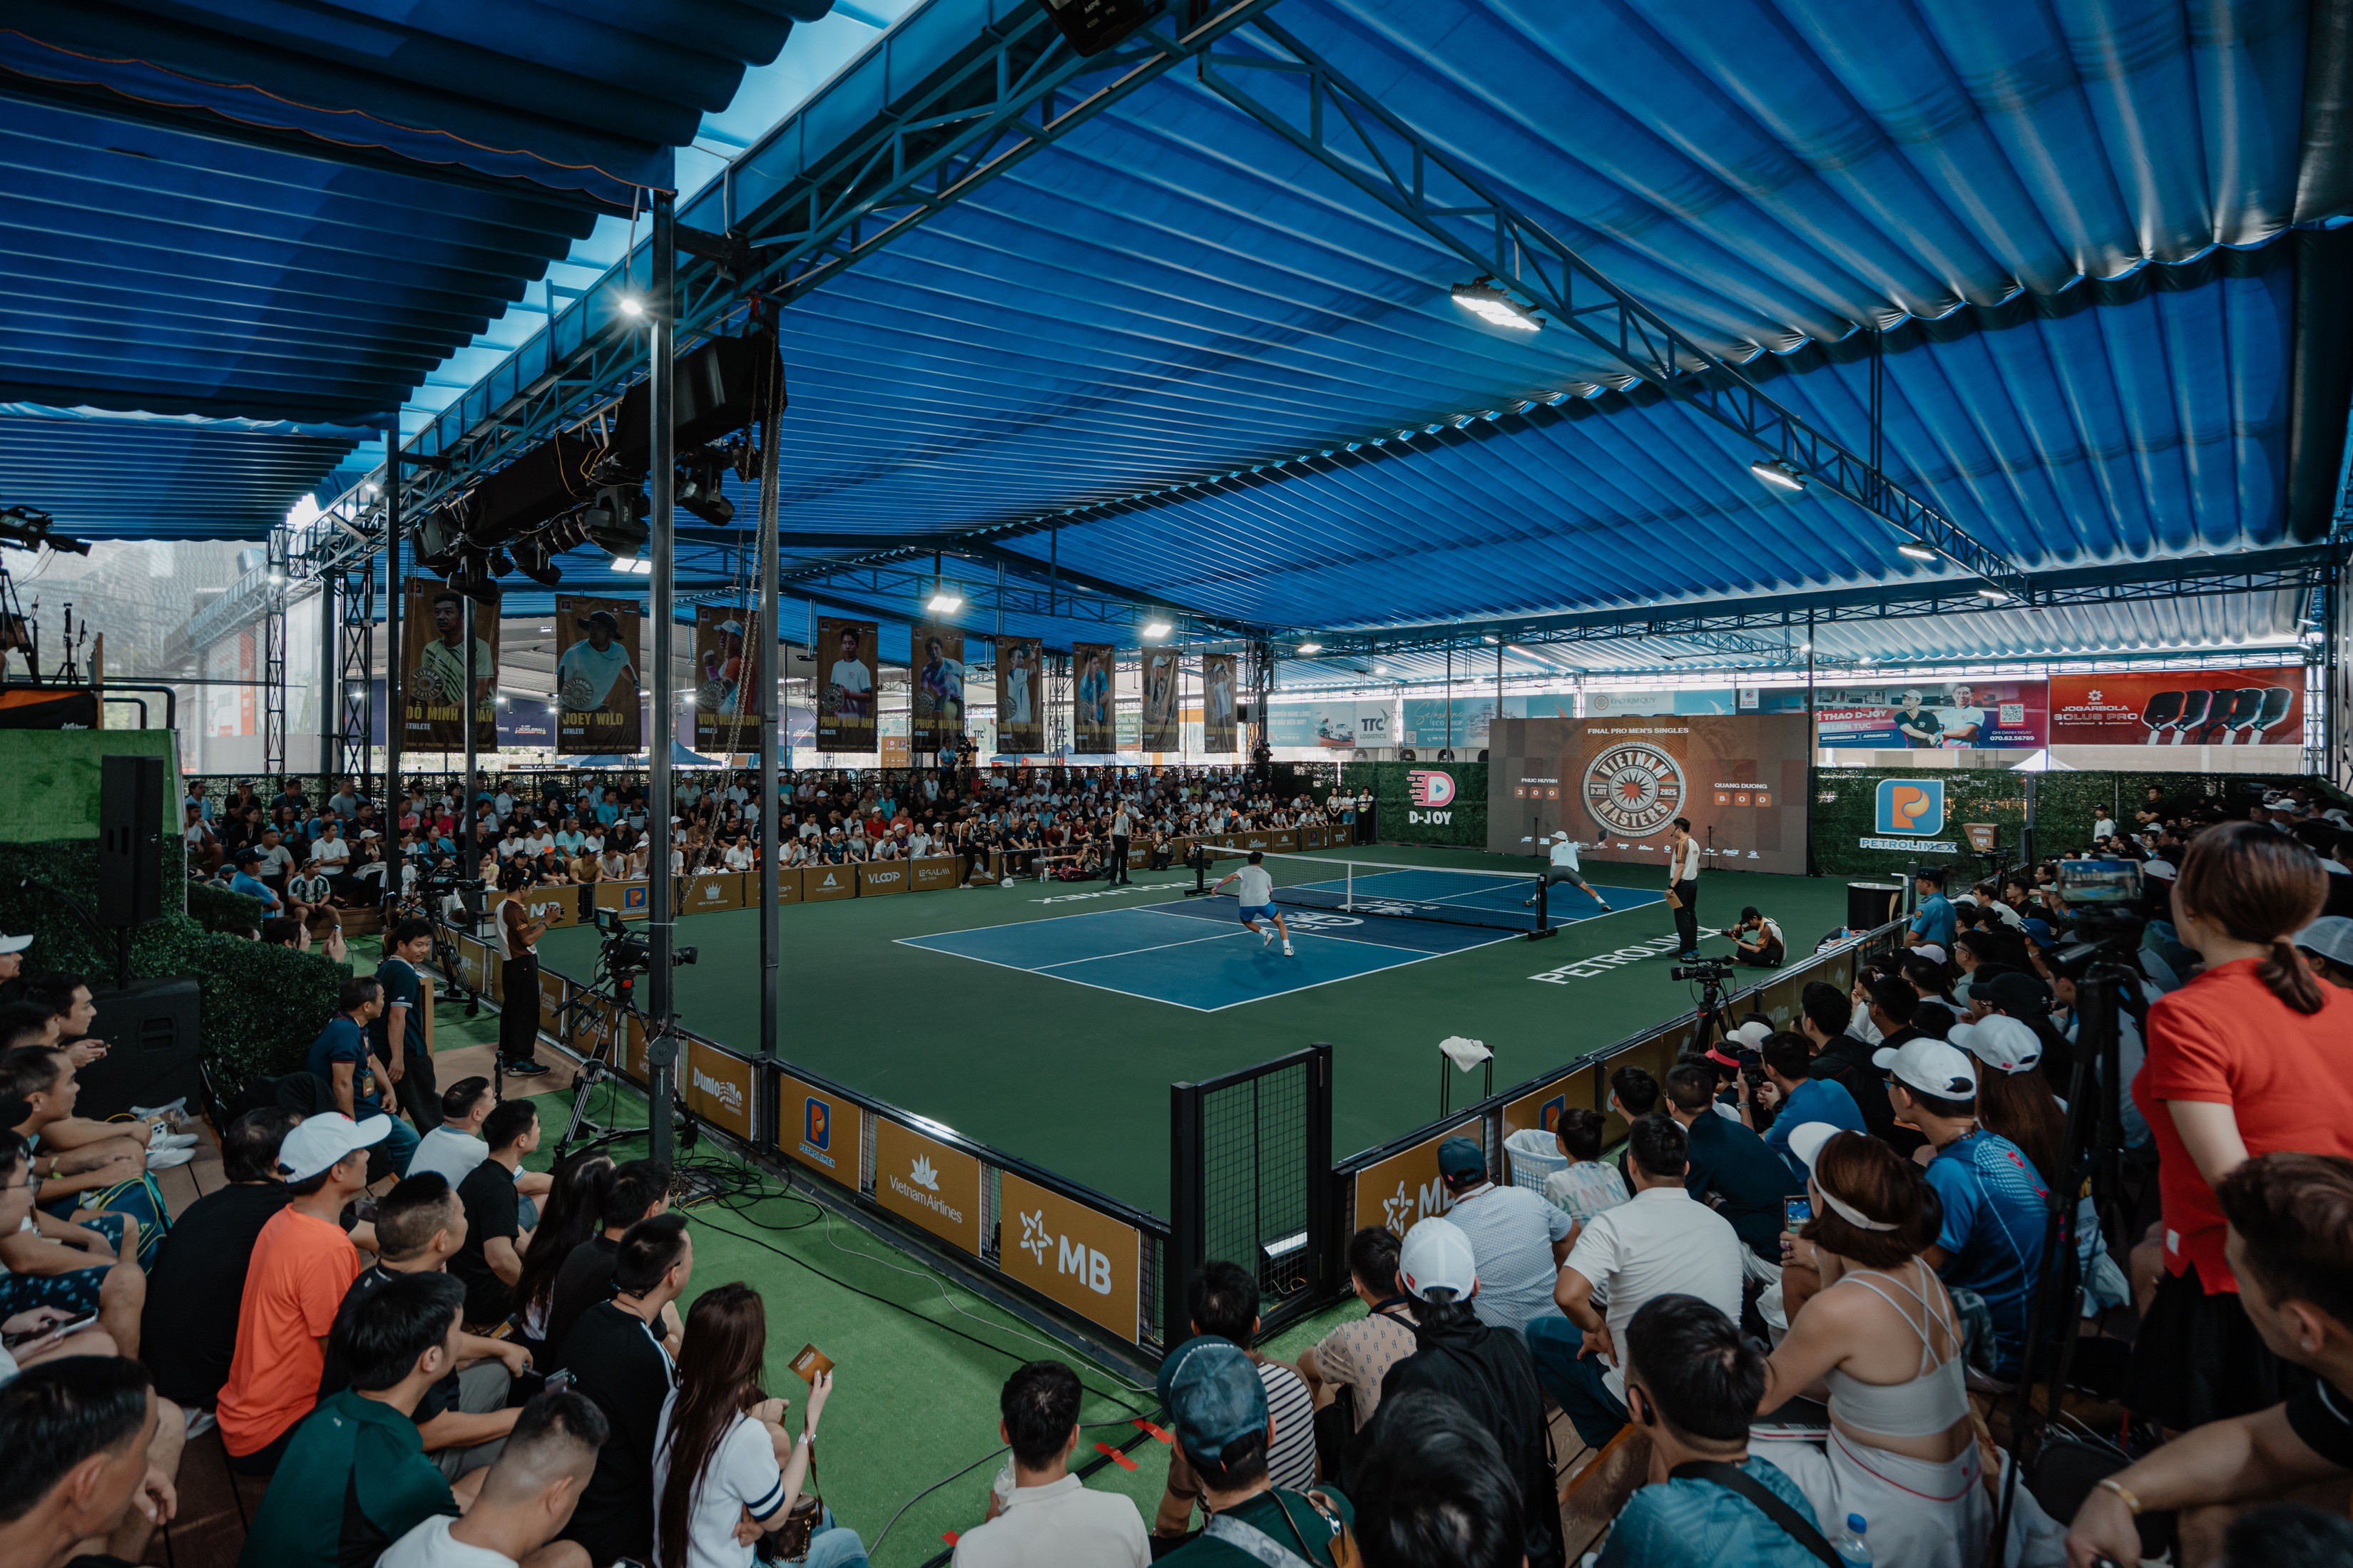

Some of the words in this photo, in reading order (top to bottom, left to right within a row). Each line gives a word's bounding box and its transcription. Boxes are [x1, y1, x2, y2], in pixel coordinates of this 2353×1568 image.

[428, 707, 459, 721] MINH
[563, 713, 592, 725] JOEY
[596, 713, 623, 725] WILD
[861, 717, 874, 728] ANH
[914, 717, 935, 729] PHÚC
[1362, 718, 1384, 732] TTC
[1599, 752, 1670, 779] VIETNAM
[1409, 811, 1452, 824] D-JOY
[1598, 799, 1668, 827] MASTERS
[1861, 839, 1957, 853] PETROLIMEX
[867, 871, 901, 884] VLOOP
[799, 1142, 835, 1169] PETROLIMEX
[890, 1174, 927, 1206] Vietnam
[927, 1194, 962, 1224] Airlines
[1418, 1177, 1456, 1222] M
[1058, 1234, 1112, 1295] MB
